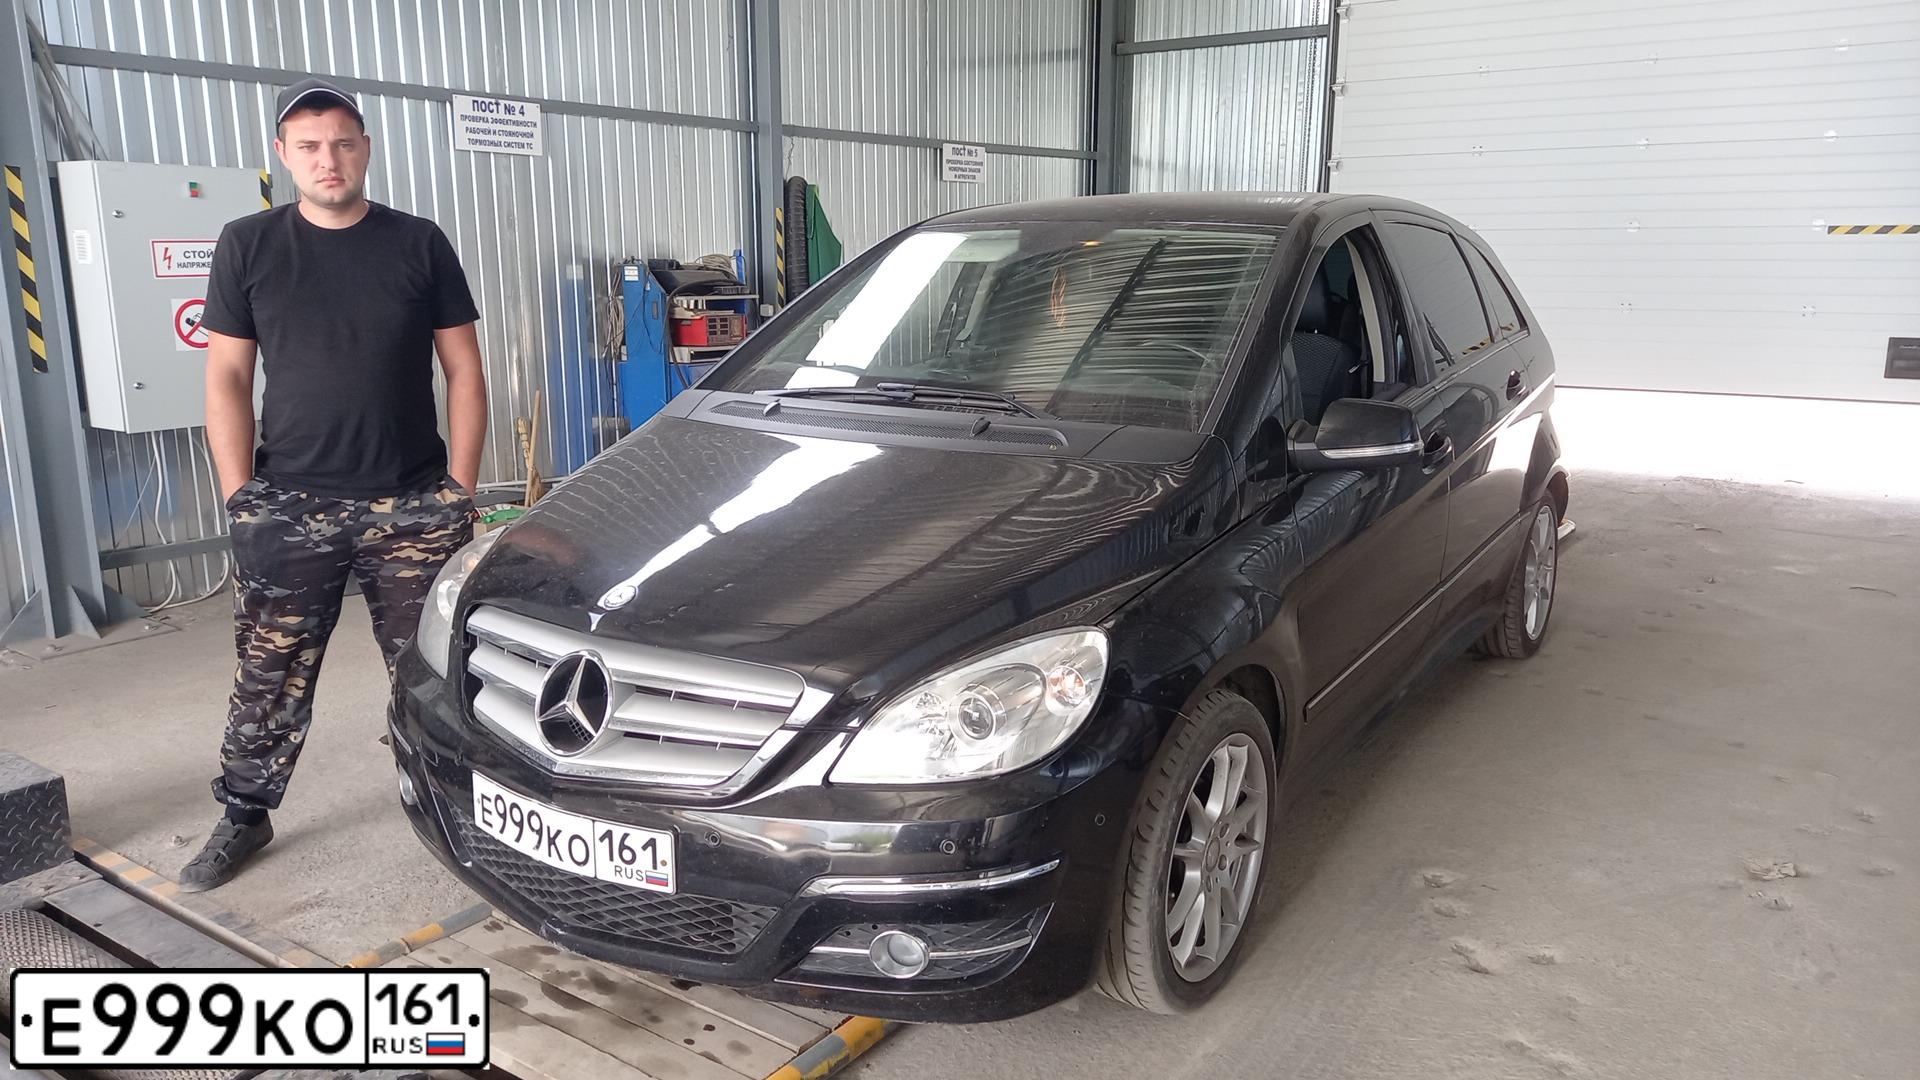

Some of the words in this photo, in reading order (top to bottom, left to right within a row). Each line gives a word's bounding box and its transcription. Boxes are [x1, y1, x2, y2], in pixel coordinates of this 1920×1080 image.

[472, 99, 501, 114] ПОСТ
[504, 103, 516, 116] №
[518, 105, 525, 117] 4
[460, 114, 490, 124] ПРОВЕРКА
[490, 117, 537, 128] ЭФФЕКТИВНОСТИ
[465, 126, 491, 136] РАБОЧЕЙ
[497, 129, 534, 139] СТОЯНОЧНОЙ
[467, 138, 502, 148] ТОРМОЗНЫХ
[503, 141, 525, 149] СИСТЕМ
[952, 147, 966, 156] ПОСТ
[967, 149, 973, 157] №
[974, 149, 978, 158] 5
[183, 248, 214, 259] СТОЙ
[177, 261, 211, 269] НАПРЯЖЕ
[481, 793, 590, 867] Е999КО
[599, 829, 658, 870] 161
[614, 865, 644, 882] RUS
